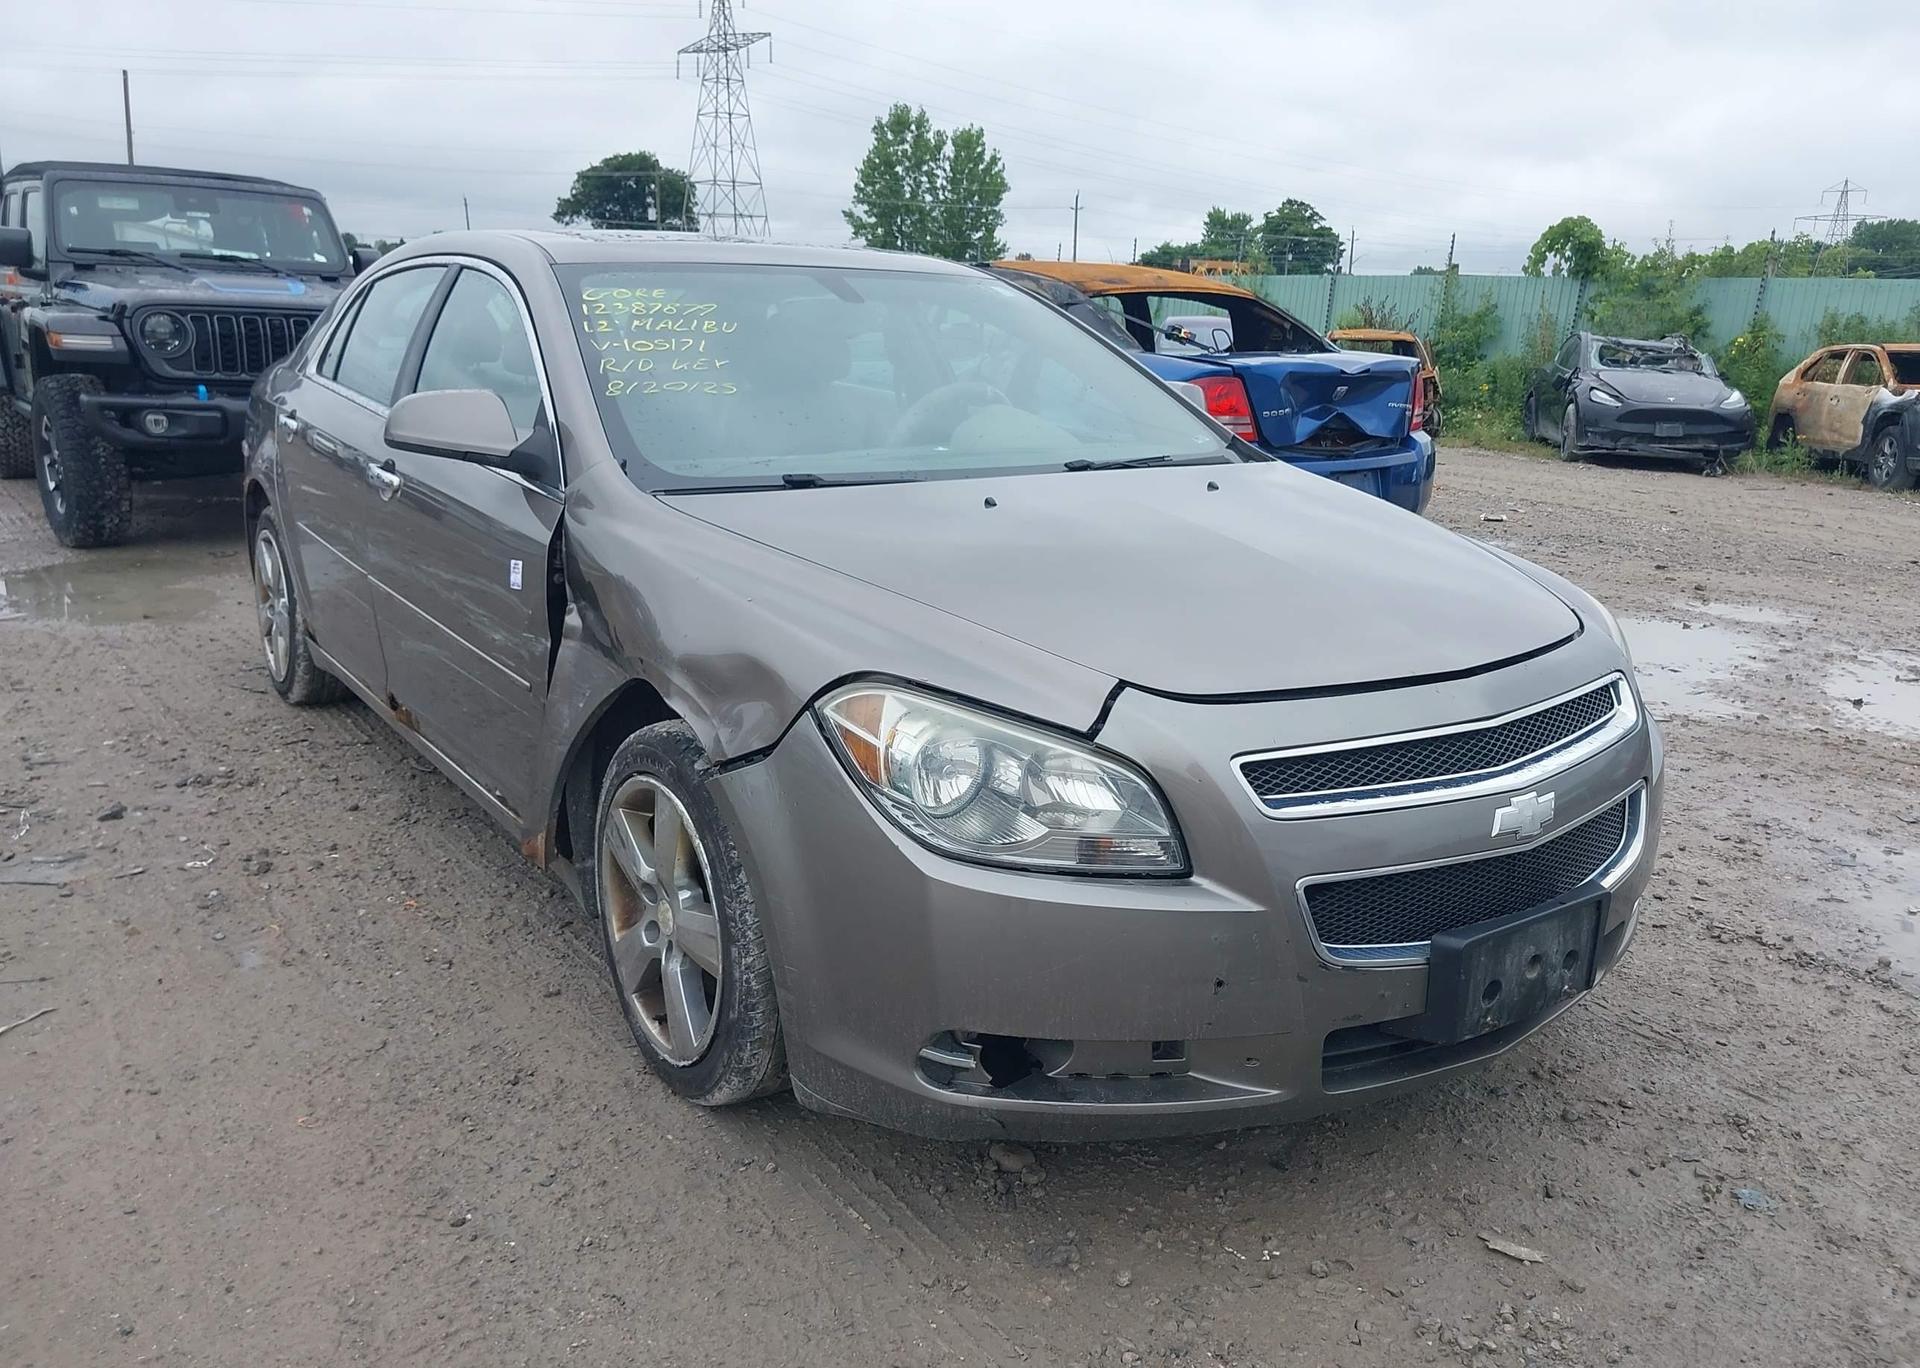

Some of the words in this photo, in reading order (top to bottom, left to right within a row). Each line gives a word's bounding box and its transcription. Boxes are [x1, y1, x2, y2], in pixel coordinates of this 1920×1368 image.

[631, 317, 738, 333] MALIBU
[600, 357, 654, 374] R/D
[672, 358, 730, 371] KEY
[605, 380, 737, 396] 8/20/25
